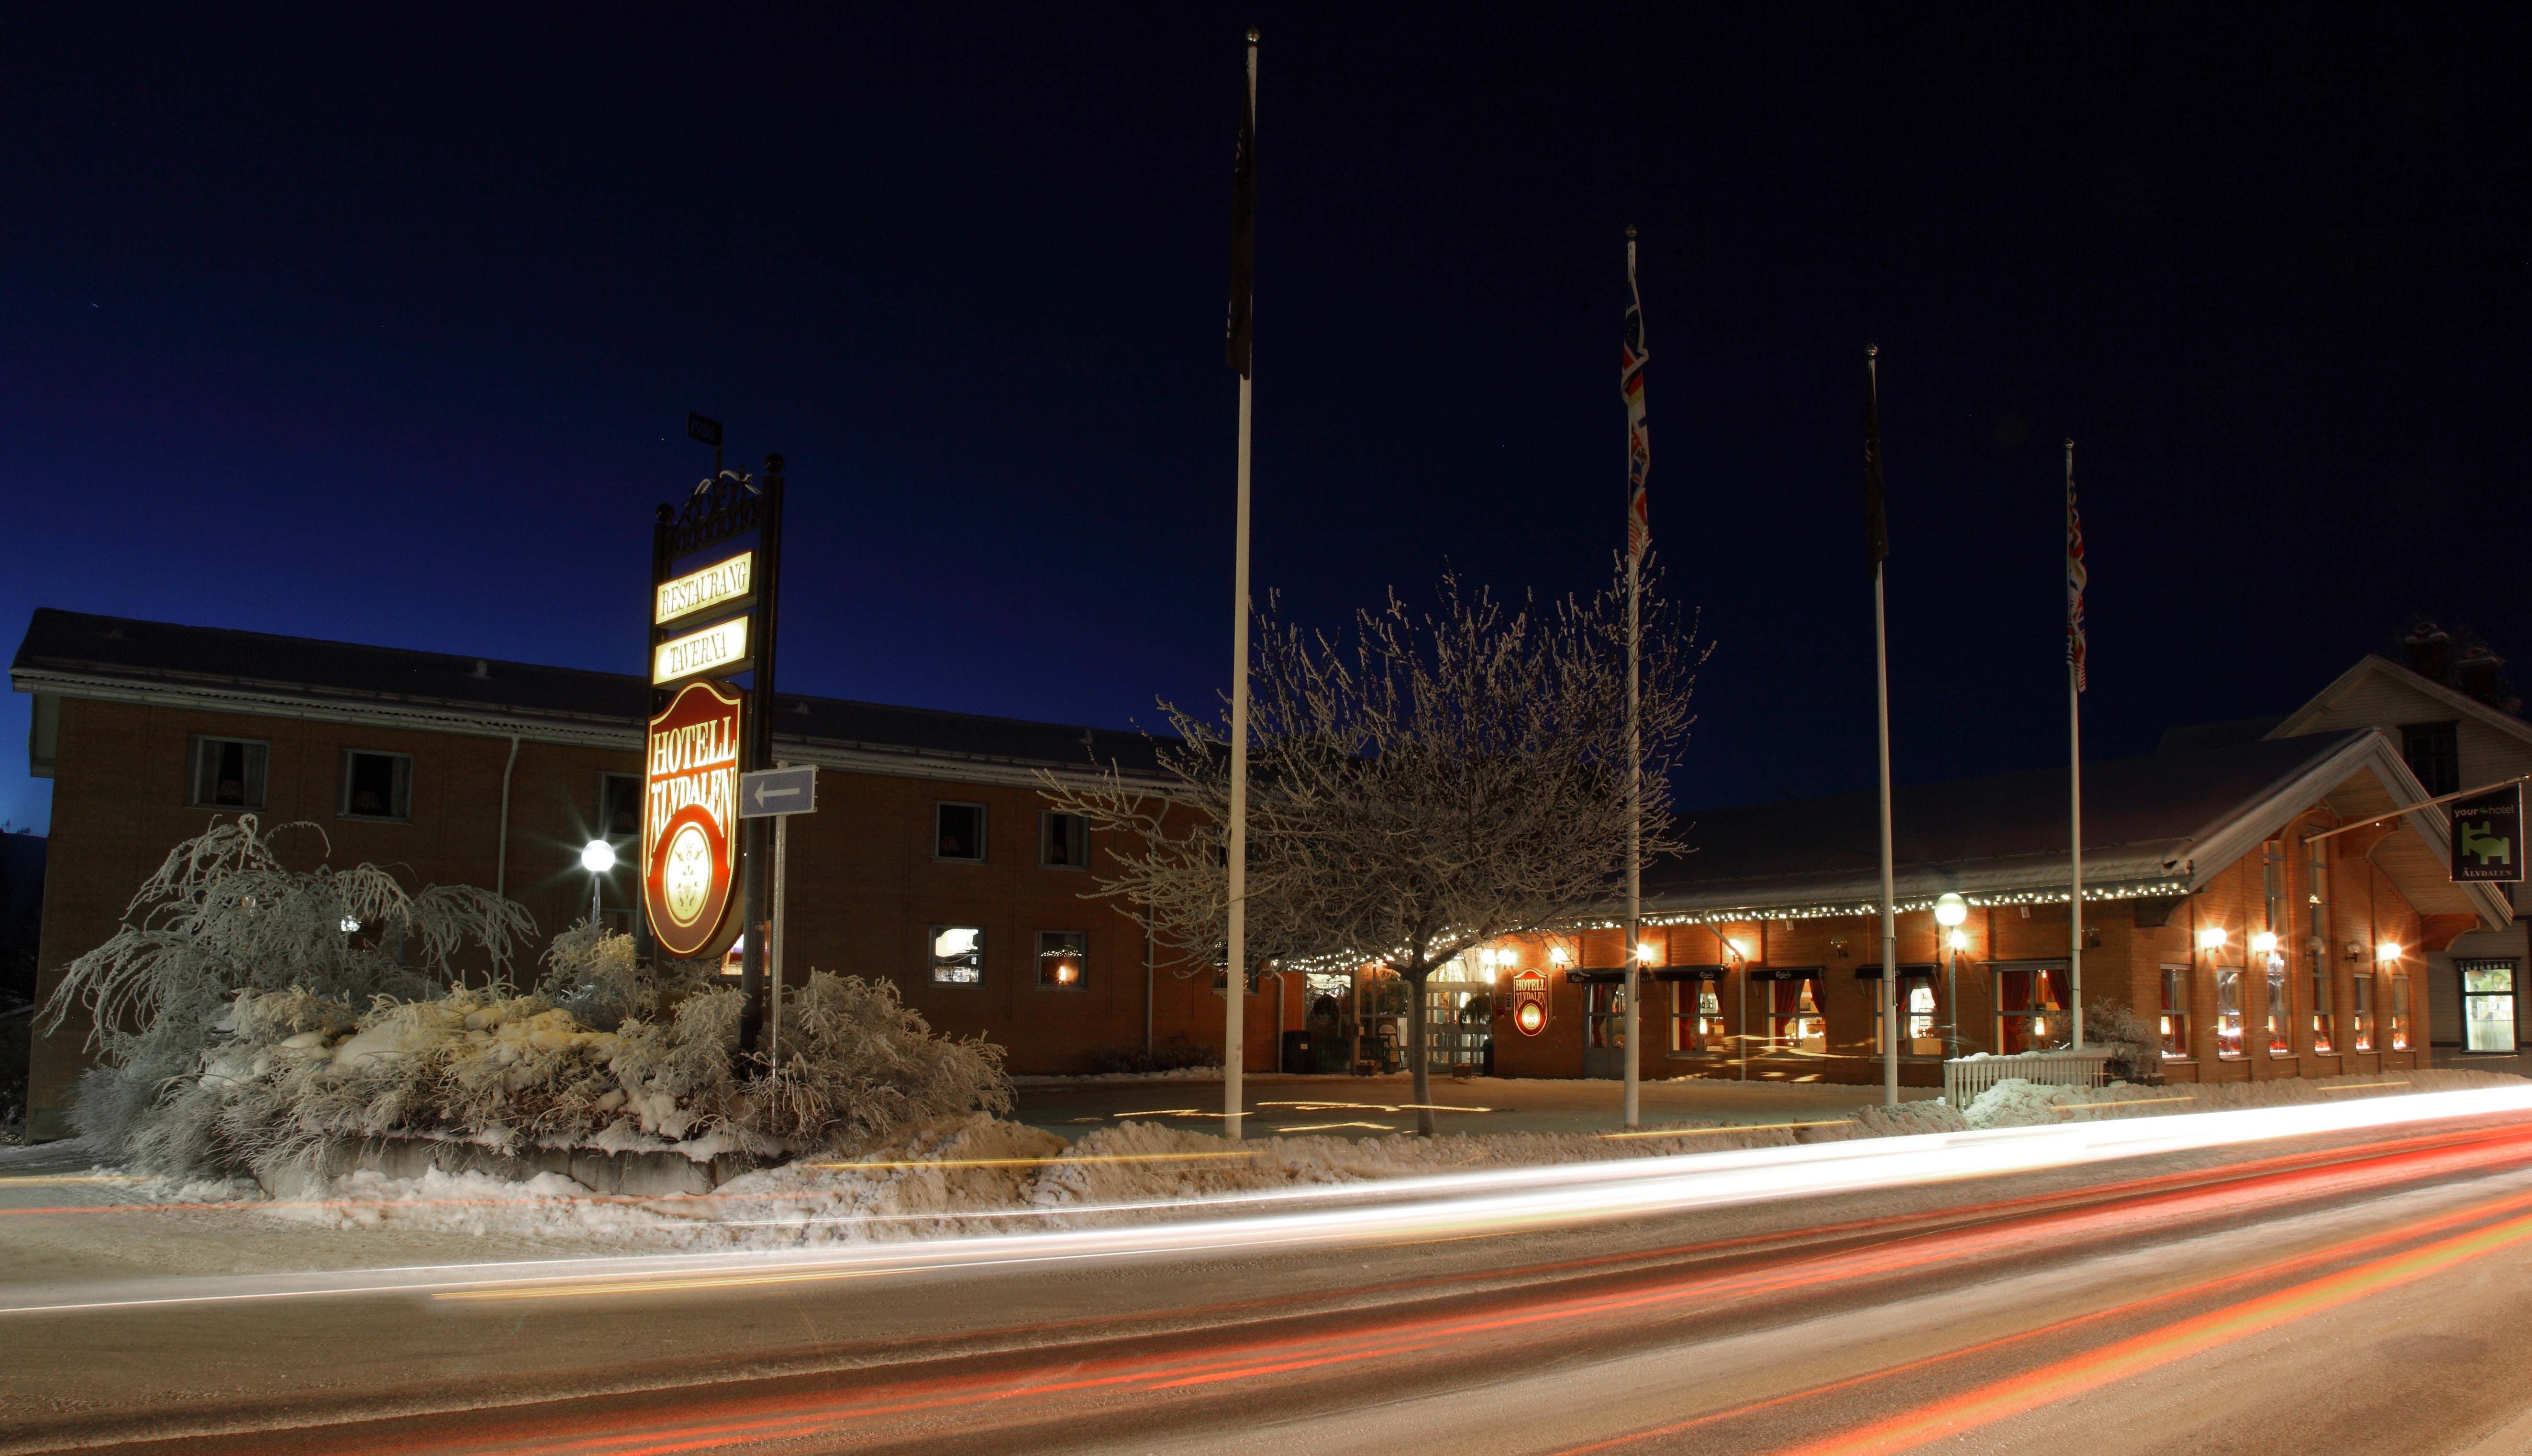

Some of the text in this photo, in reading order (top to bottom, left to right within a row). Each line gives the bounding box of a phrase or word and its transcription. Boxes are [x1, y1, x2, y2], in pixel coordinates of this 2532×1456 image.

[662, 562, 746, 616] RESTAURANG
[670, 632, 726, 673] TAVERNA
[651, 716, 735, 776] HOTELL
[647, 767, 735, 877] ÄLVDALEN
[2454, 805, 2514, 818] your hotel
[2462, 867, 2511, 876] ÄLVDALEN
[1516, 979, 1546, 991] HOTELL
